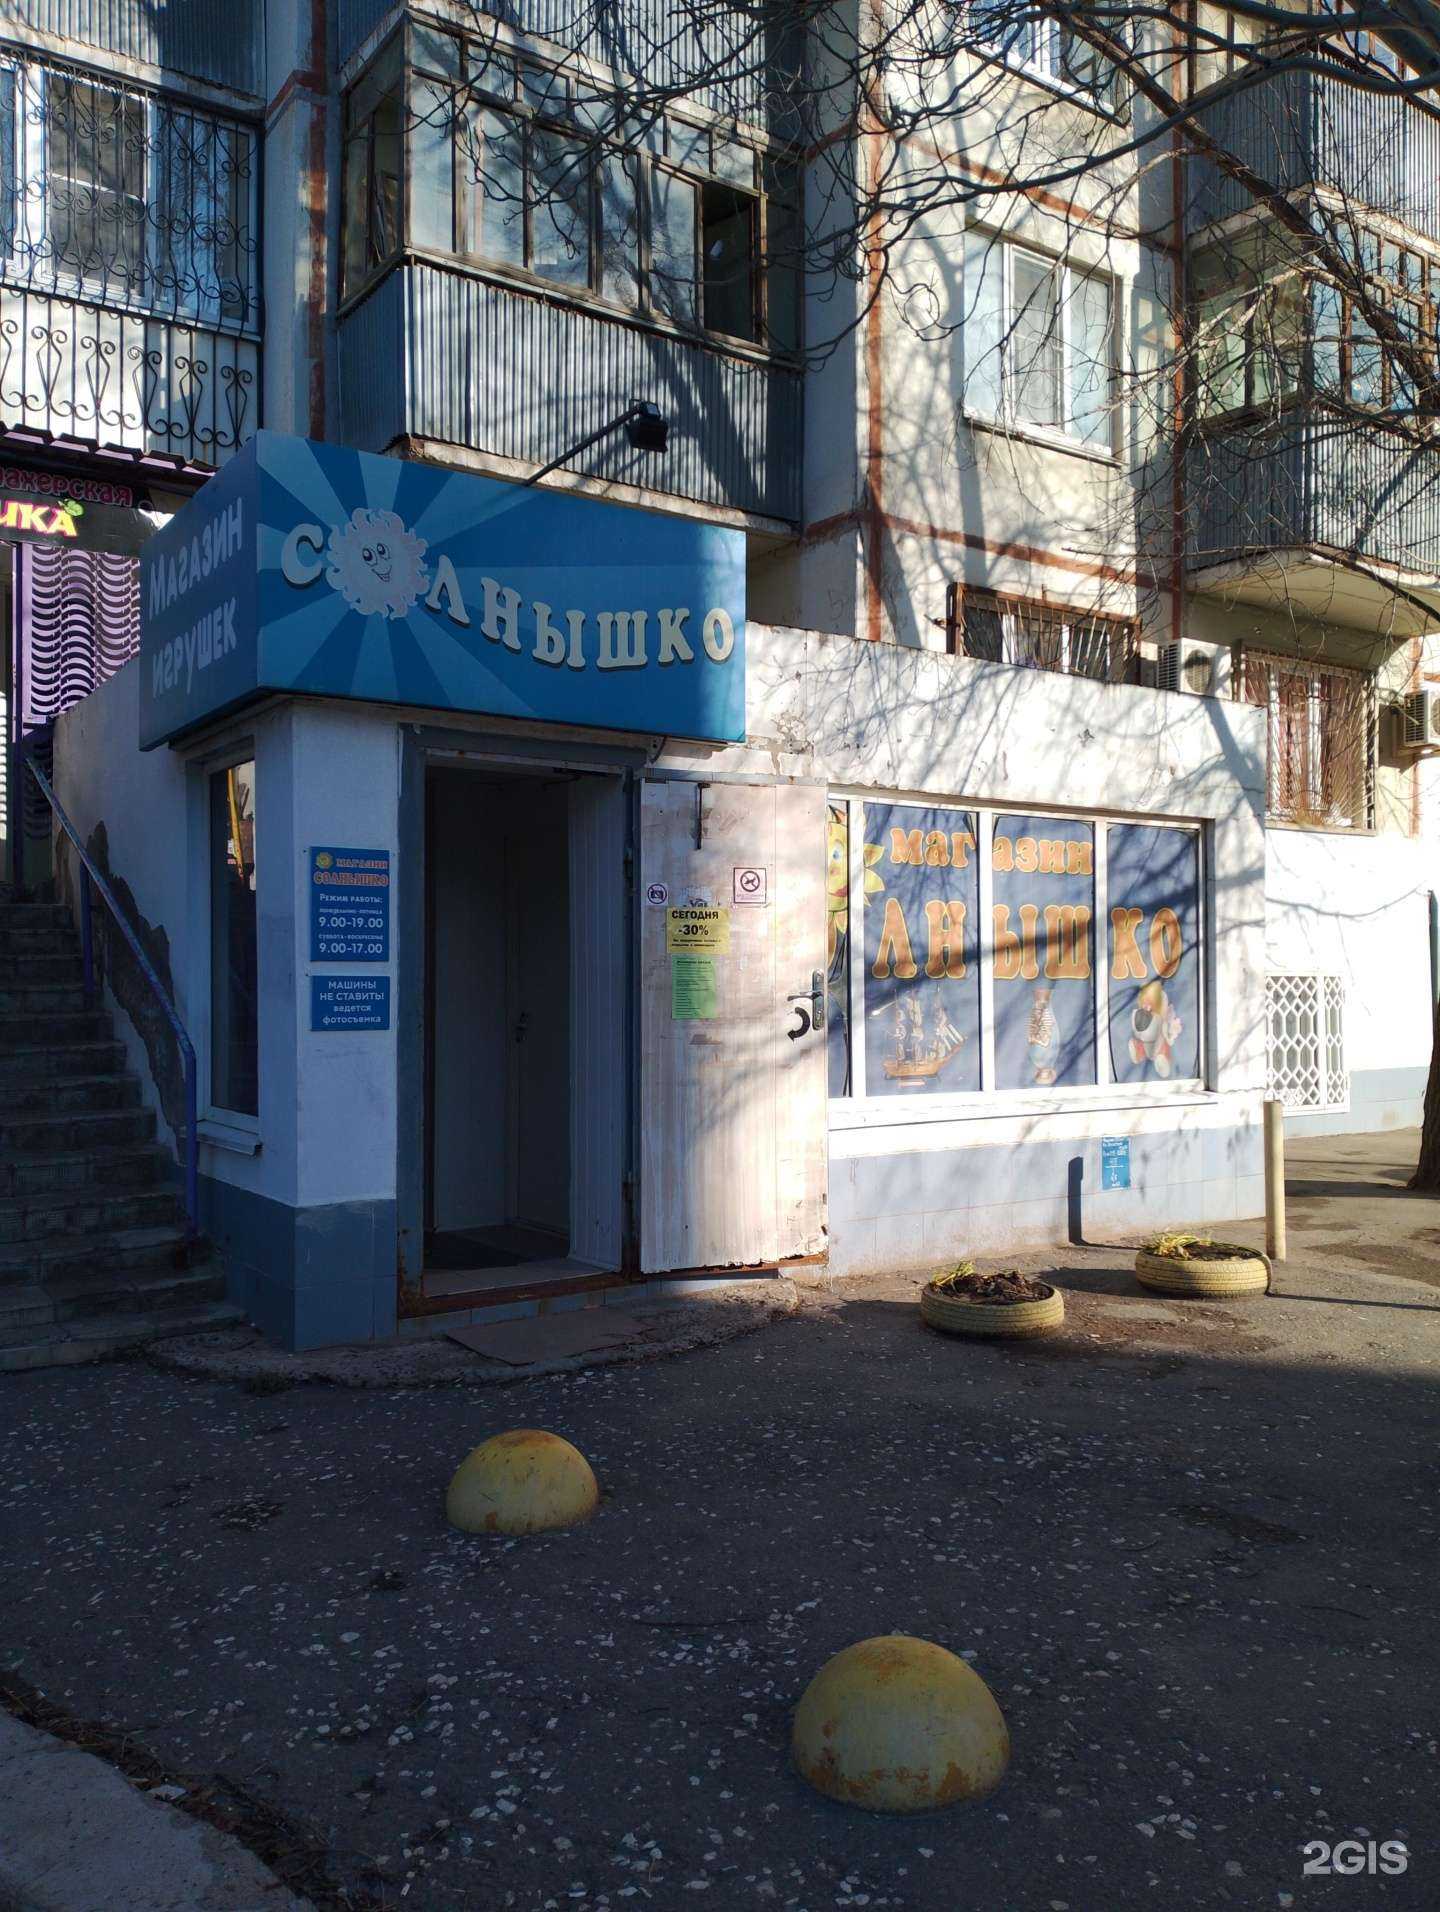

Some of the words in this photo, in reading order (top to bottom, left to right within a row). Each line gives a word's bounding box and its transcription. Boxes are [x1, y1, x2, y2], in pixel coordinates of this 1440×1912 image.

[671, 910, 719, 920] СЕГОДНЯ
[678, 924, 709, 936] -30%
[328, 980, 376, 989] МАШИНЫ
[320, 992, 334, 1001] НЕ
